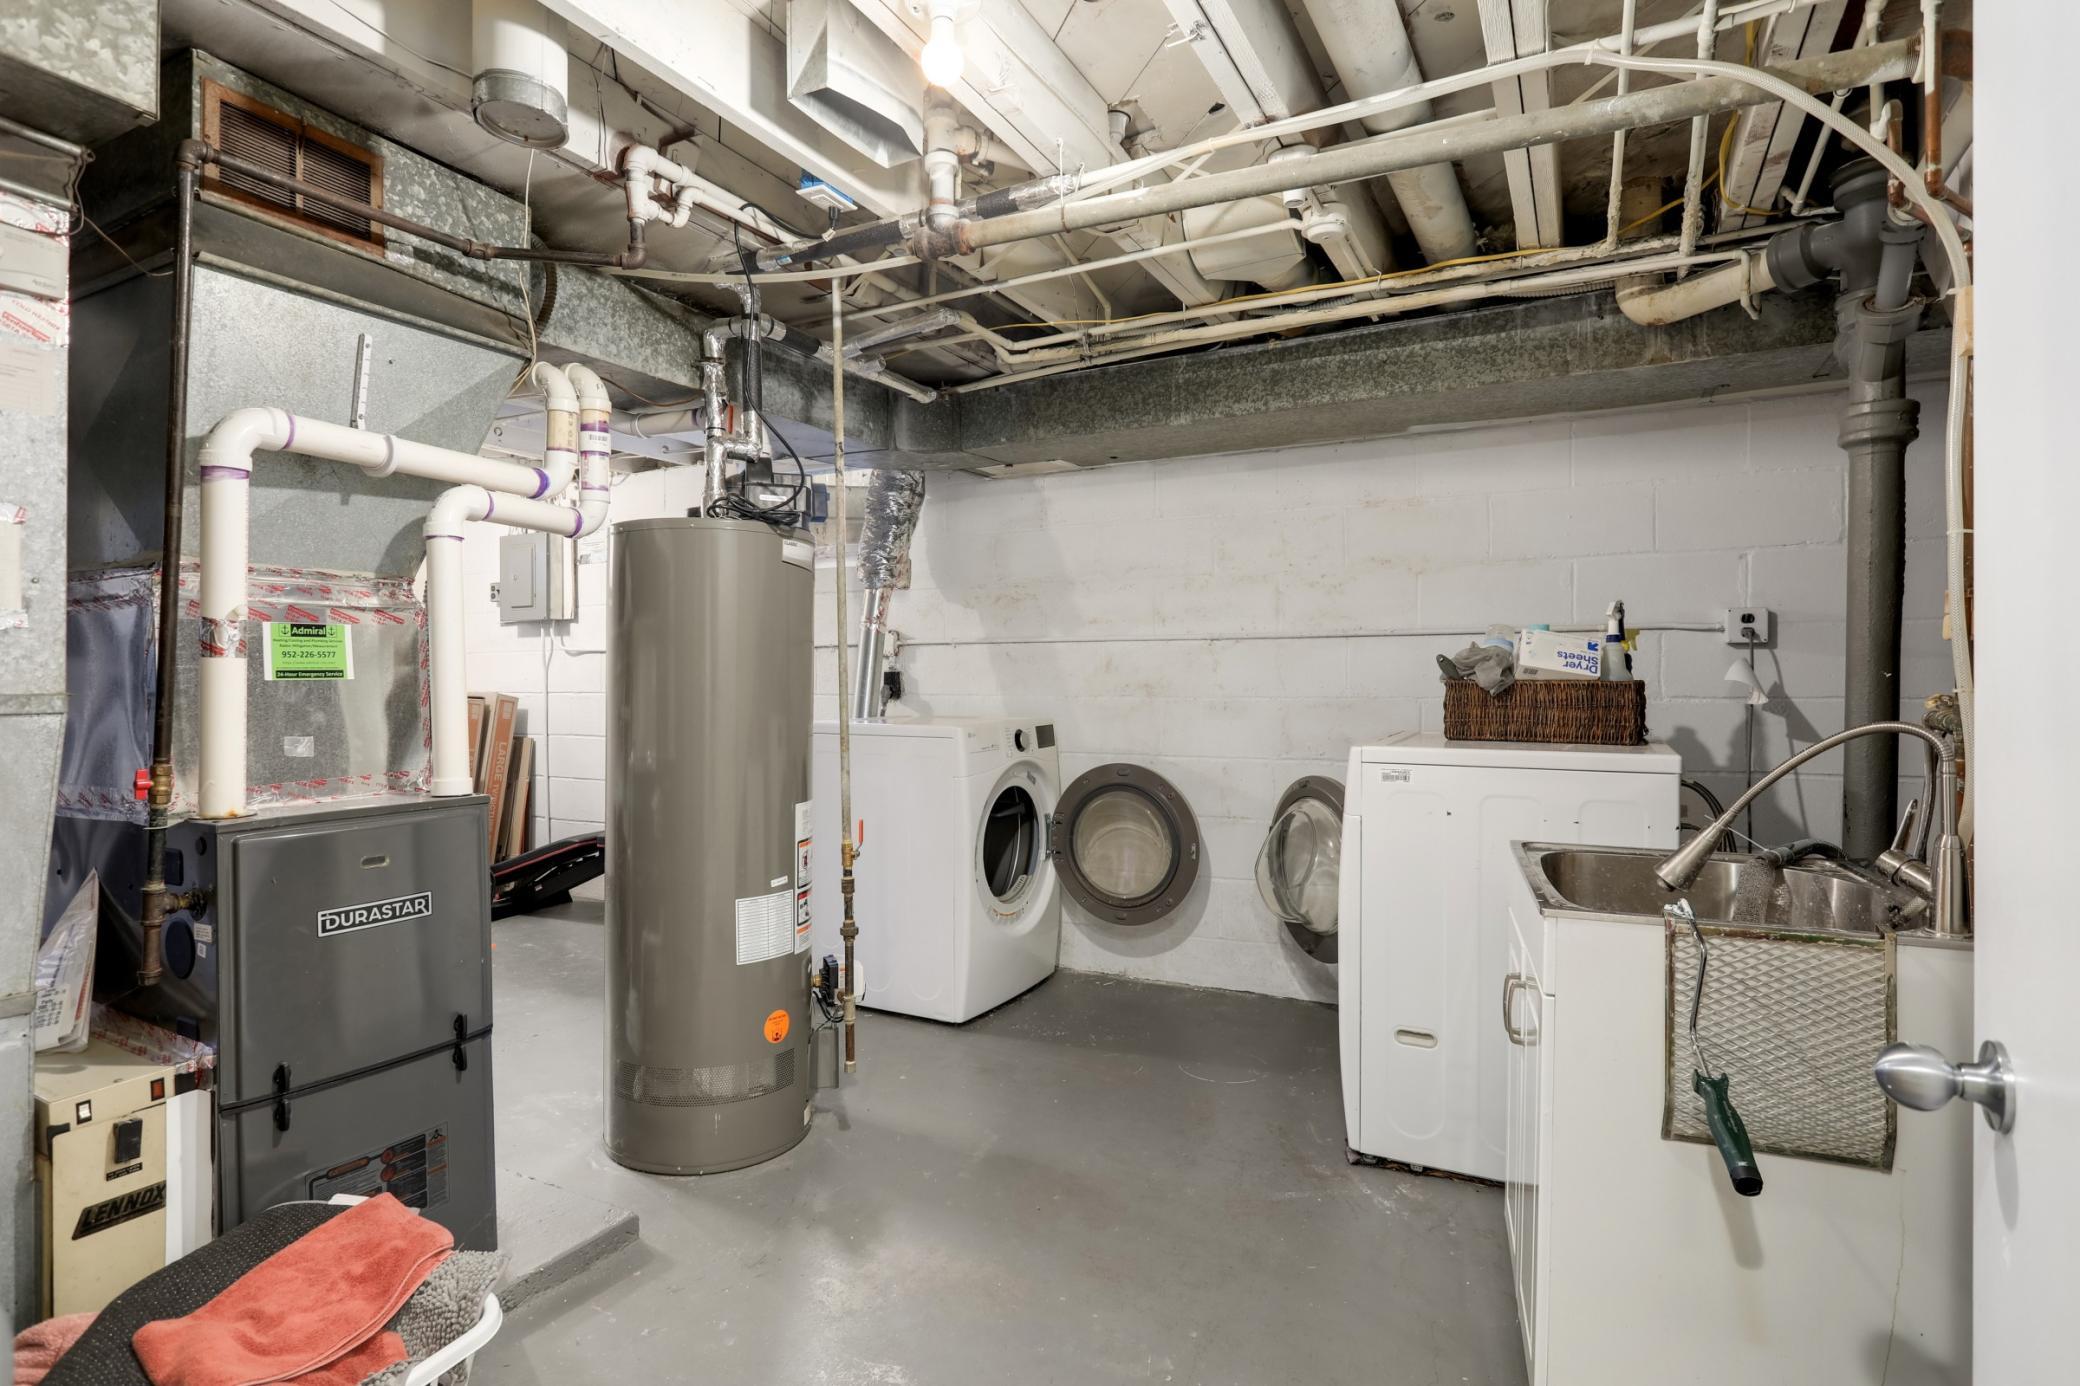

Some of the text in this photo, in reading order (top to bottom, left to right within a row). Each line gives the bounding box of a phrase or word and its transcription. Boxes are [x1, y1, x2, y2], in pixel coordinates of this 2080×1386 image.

[291, 626, 326, 636] Admiral
[281, 650, 336, 659] 952-226-5577
[1556, 650, 1599, 666] Sheets
[1562, 660, 1598, 675] Dryer
[495, 742, 508, 783] LARGE
[325, 898, 428, 931] DURASTAR
[80, 1183, 166, 1228] LENNOX
